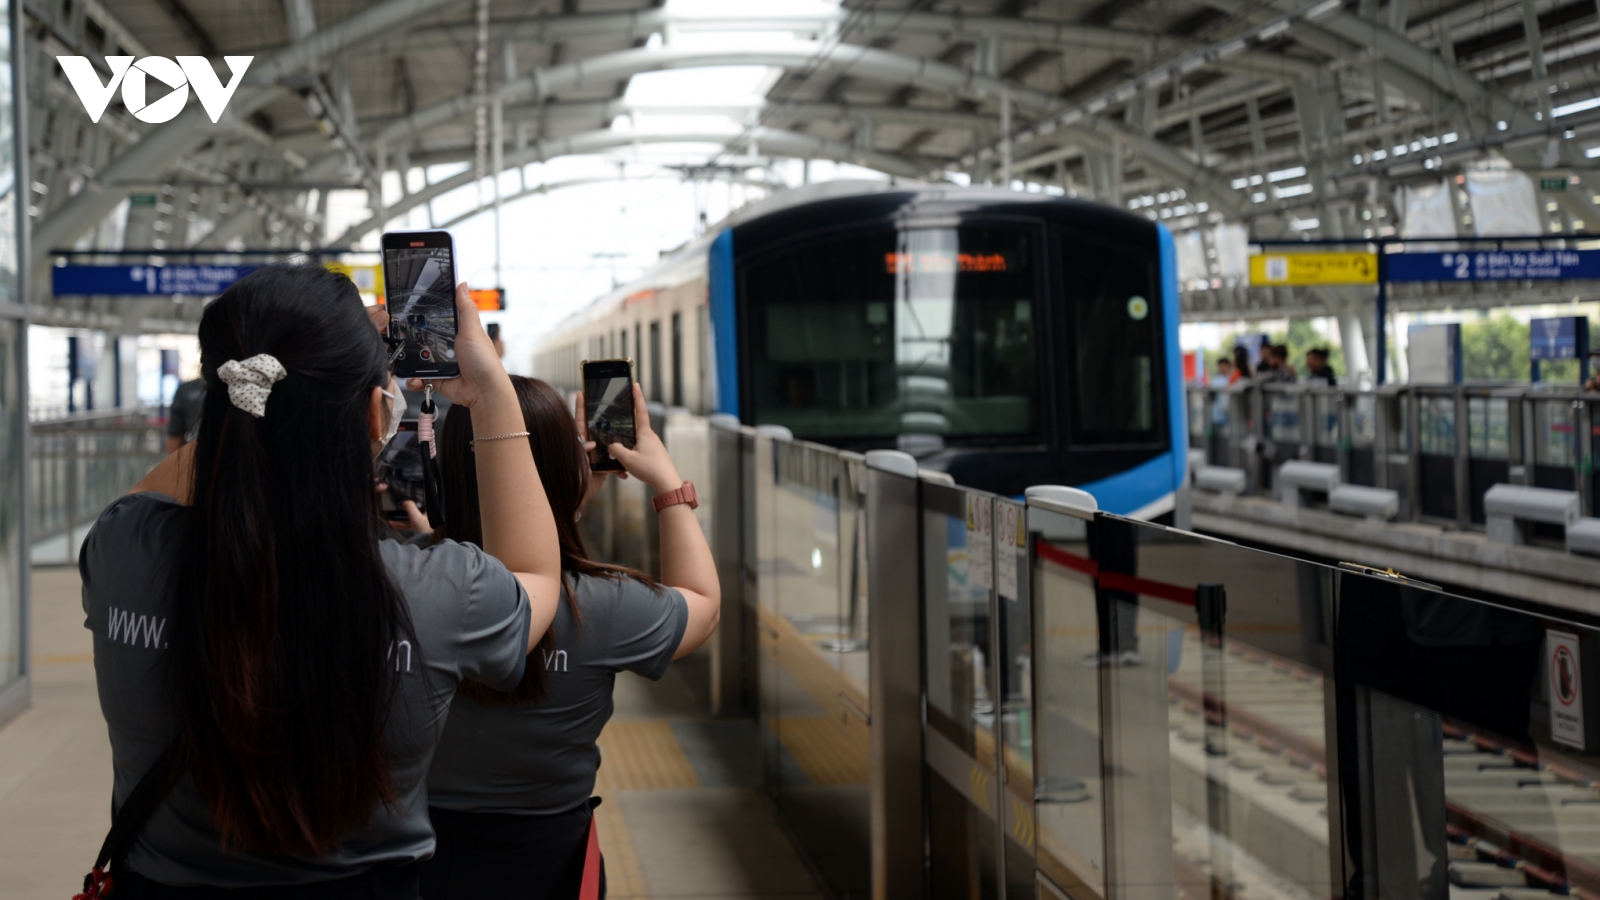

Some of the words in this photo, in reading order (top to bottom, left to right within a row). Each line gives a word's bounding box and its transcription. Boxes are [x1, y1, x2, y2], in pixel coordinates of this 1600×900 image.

[1455, 253, 1470, 279] 2
[145, 267, 157, 293] 1
[108, 606, 168, 650] www.
